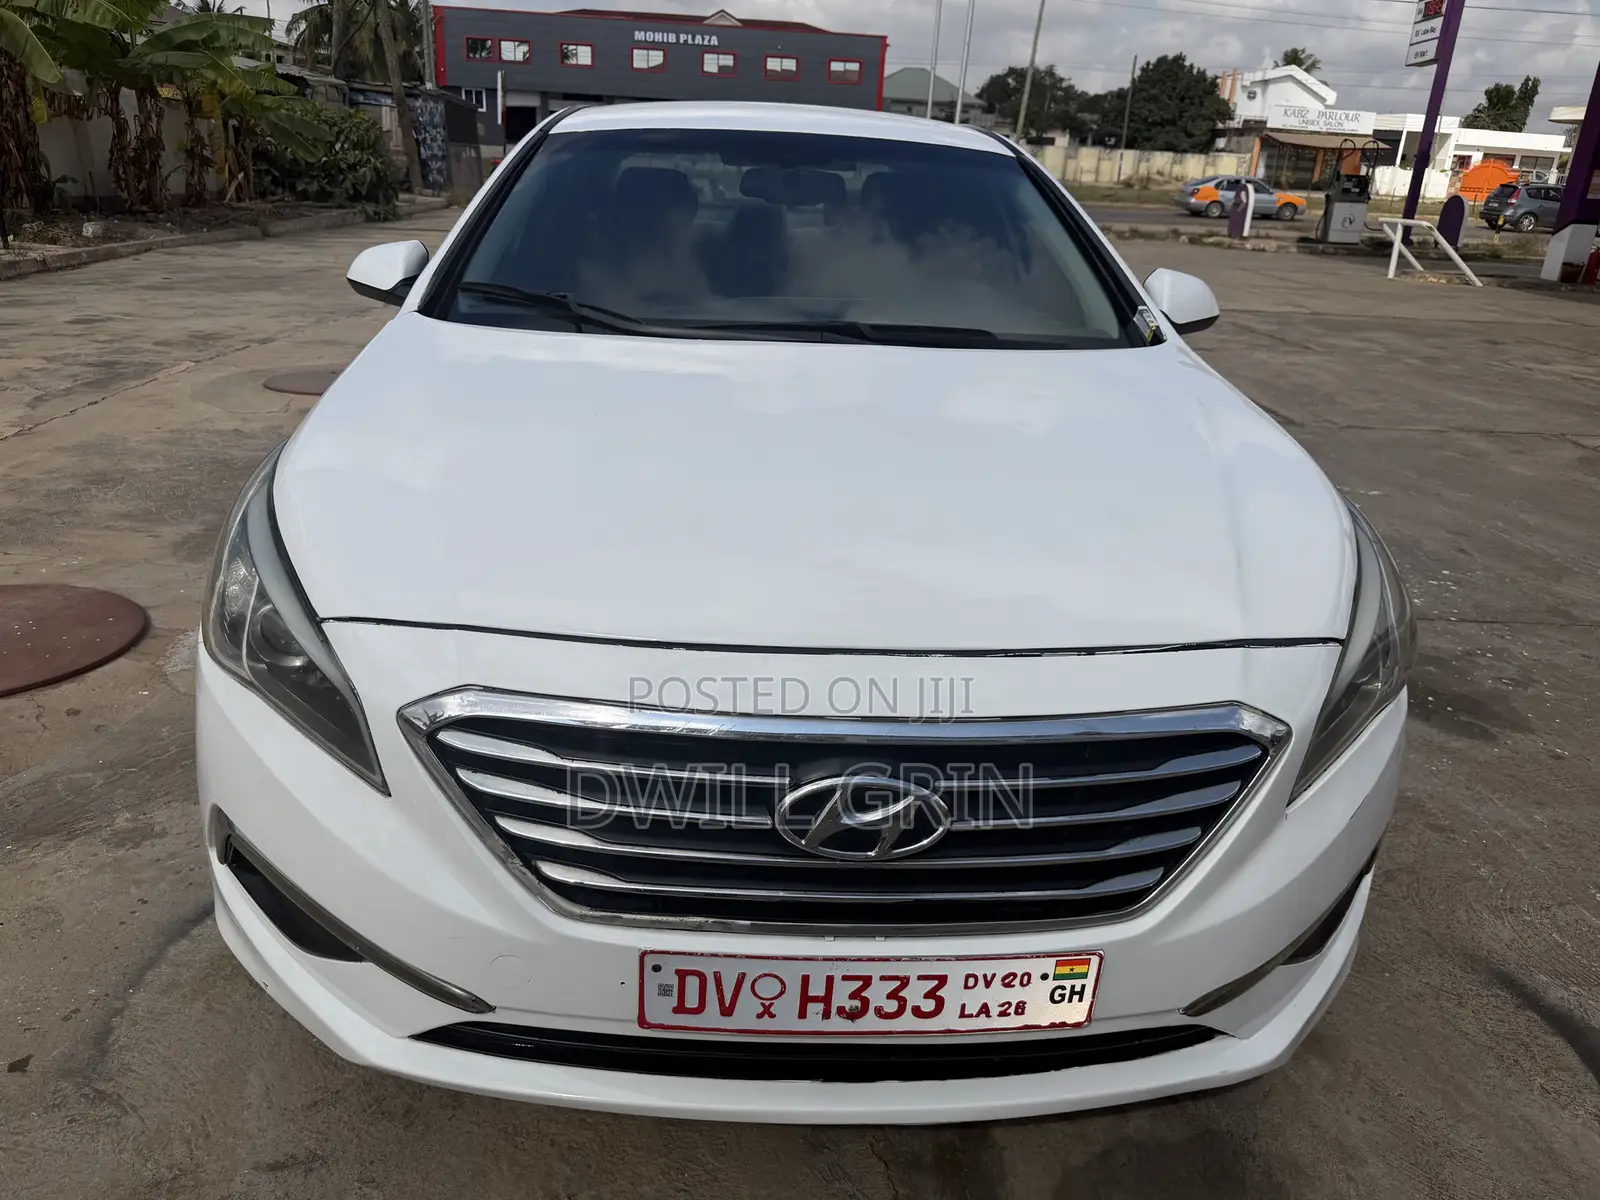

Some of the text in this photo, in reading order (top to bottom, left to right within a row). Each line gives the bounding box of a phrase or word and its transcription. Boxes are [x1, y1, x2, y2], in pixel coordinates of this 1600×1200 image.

[634, 30, 719, 46] MOHIB PLAZA
[1298, 119, 1321, 127] UNISEX
[1317, 110, 1360, 122] PARLOUR
[671, 968, 747, 1017] DV
[797, 973, 948, 1021] H333
[1049, 983, 1087, 1005] GH
